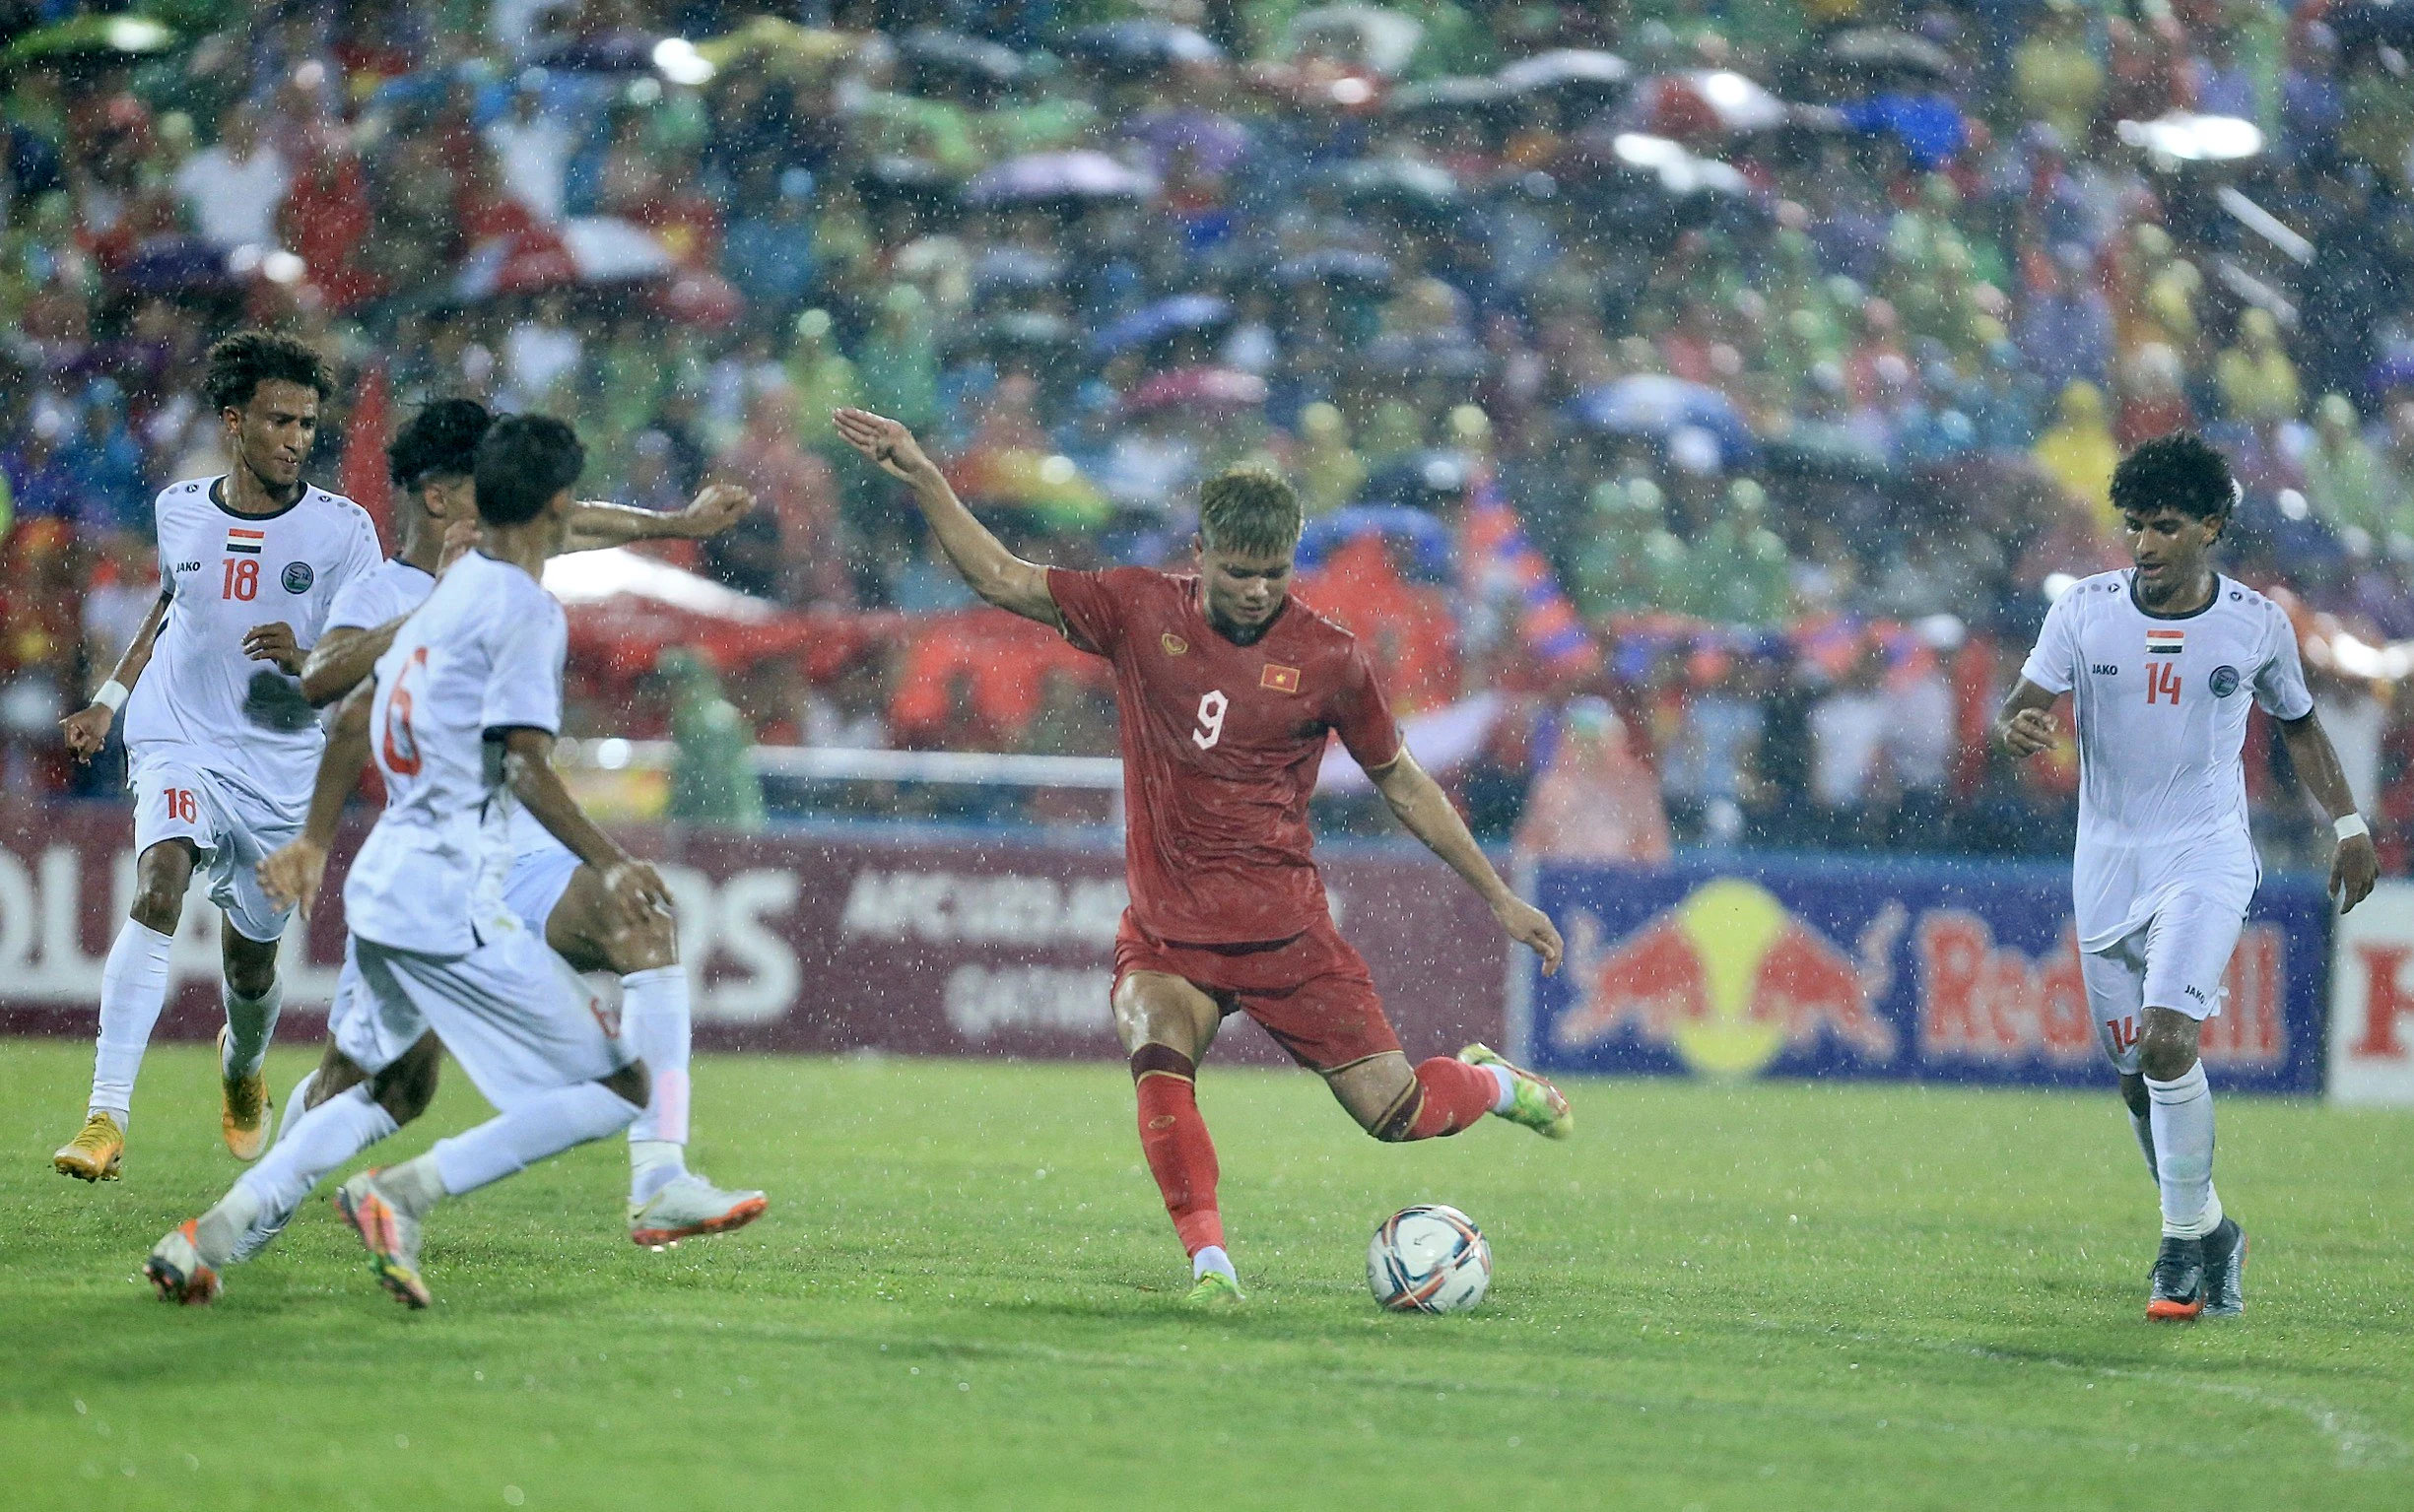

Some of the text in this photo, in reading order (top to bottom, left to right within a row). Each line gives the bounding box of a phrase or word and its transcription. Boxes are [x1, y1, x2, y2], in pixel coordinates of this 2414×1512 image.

[175, 560, 201, 573] JAKO
[222, 559, 260, 602] 18
[2092, 663, 2118, 676] JAKO
[2145, 662, 2182, 705] 14
[1192, 690, 1229, 751] 9
[164, 788, 197, 824] 18
[1919, 911, 2096, 1058] Red
[2107, 1016, 2141, 1054] 14
